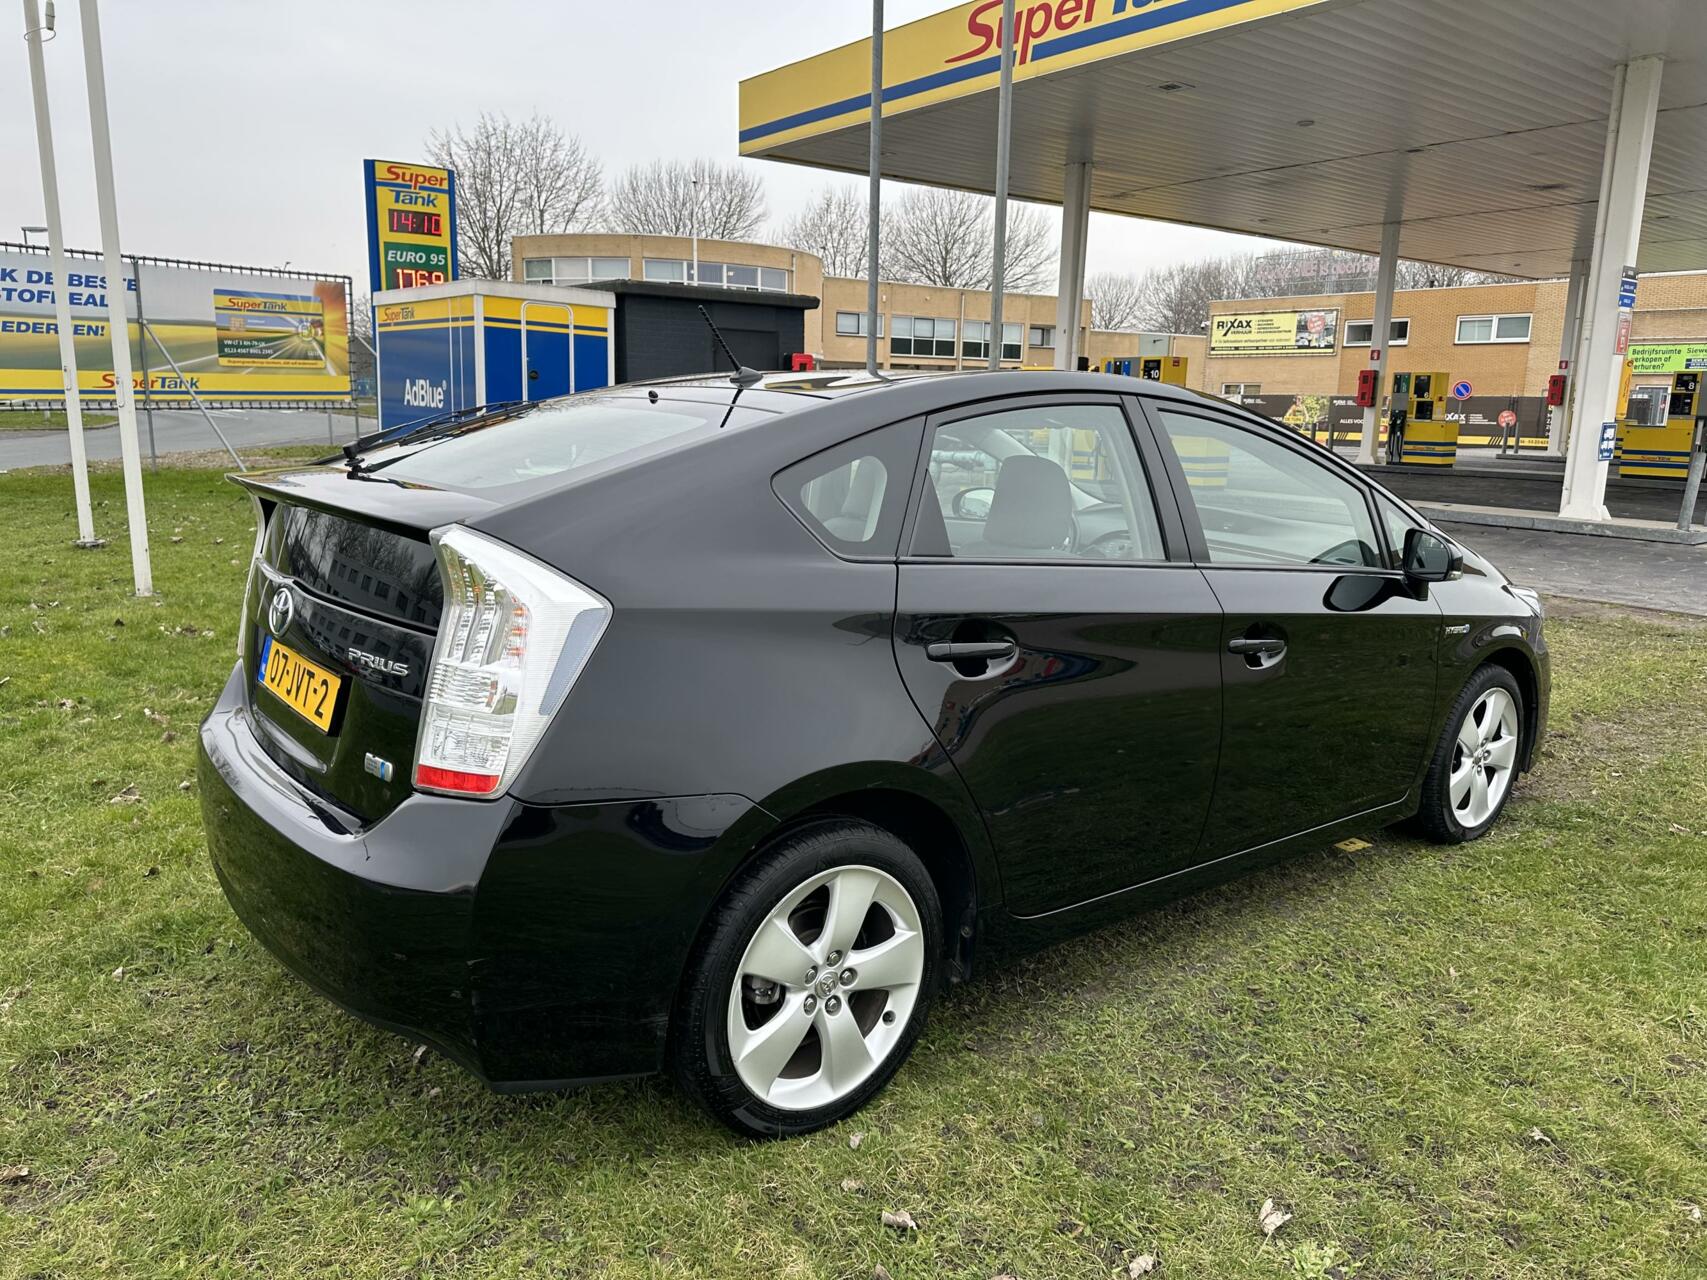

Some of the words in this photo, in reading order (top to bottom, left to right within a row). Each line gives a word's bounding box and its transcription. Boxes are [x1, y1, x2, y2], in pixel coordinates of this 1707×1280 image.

[377, 165, 447, 190] Super
[388, 189, 437, 208] Tank
[387, 250, 426, 263] EURO
[430, 253, 446, 266] 95
[27, 270, 54, 285] DE
[68, 273, 137, 291] BESE
[228, 298, 288, 312] SuperTank
[383, 306, 415, 323] SuperTank
[1, 320, 105, 337] EDEREN!
[1217, 318, 1252, 337] RIXAX
[1632, 348, 1682, 356] Bedrijfsruimte
[92, 373, 200, 390] SperTank
[1150, 369, 1160, 378] 10
[1688, 382, 1695, 390] 8
[348, 647, 409, 677] PRIUS
[270, 648, 329, 720] 07-JVT-2
